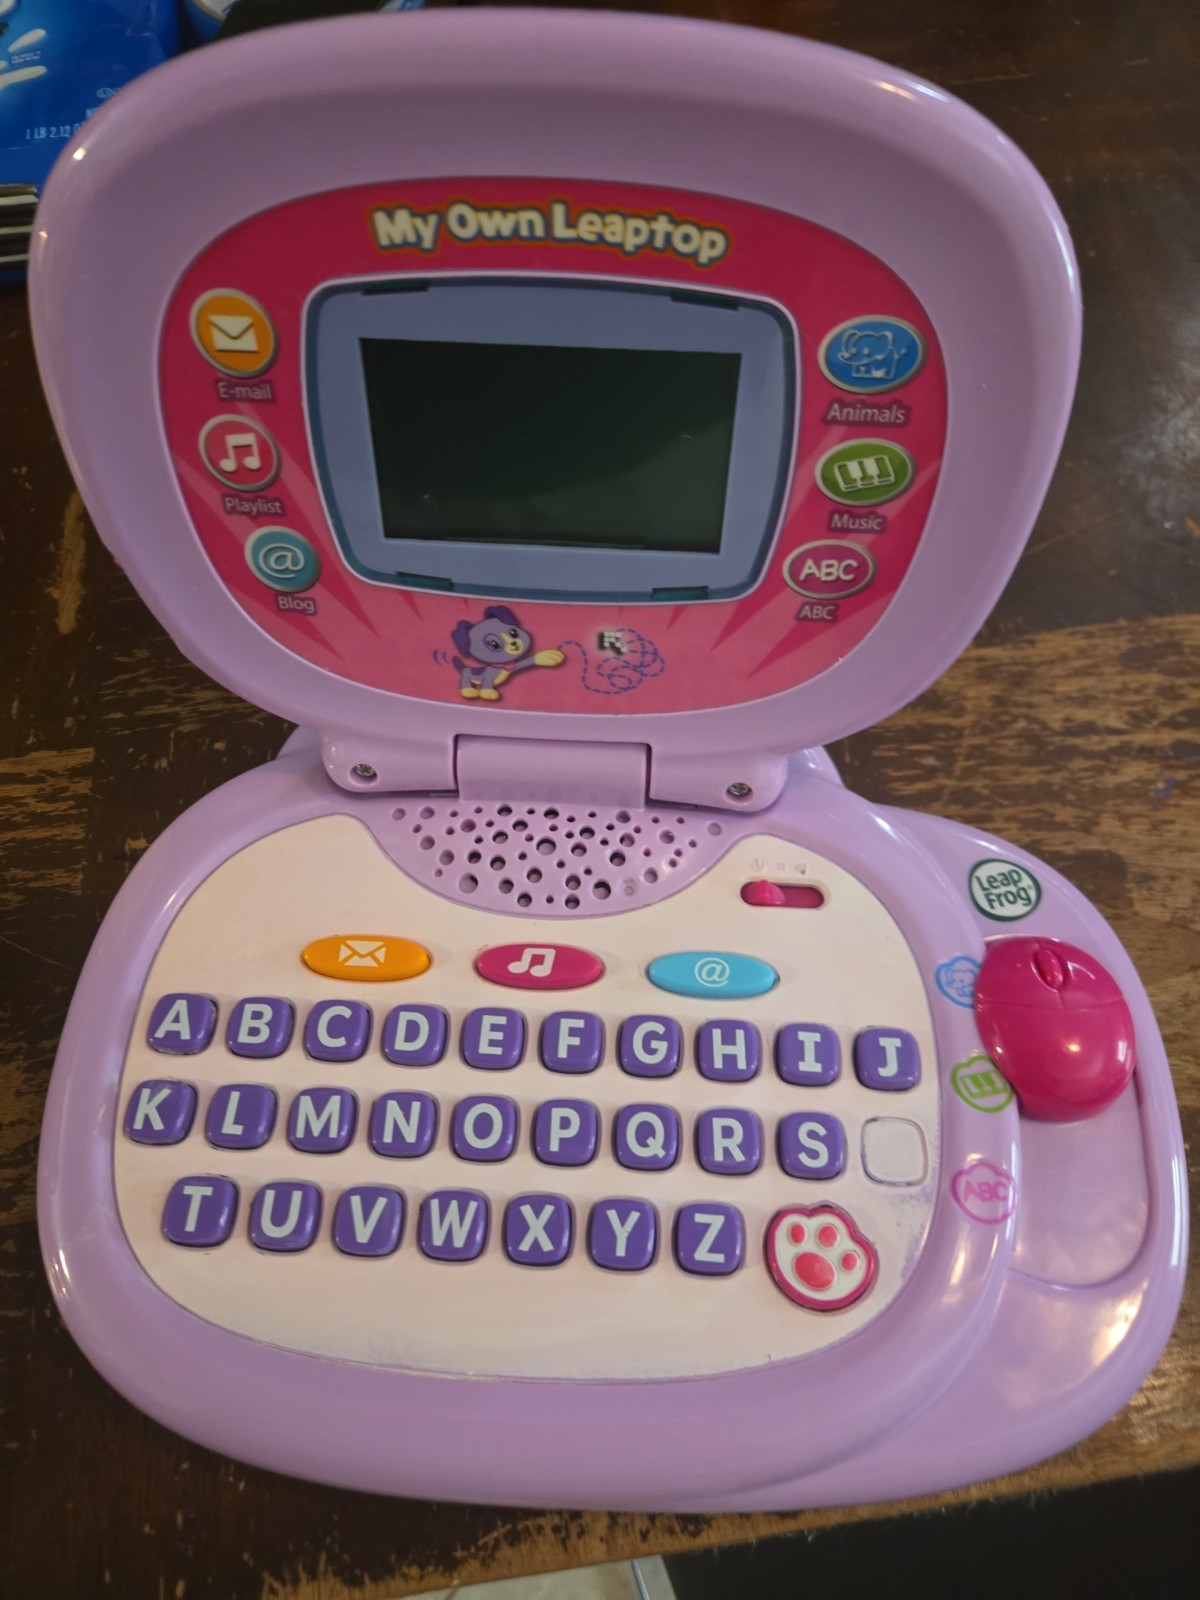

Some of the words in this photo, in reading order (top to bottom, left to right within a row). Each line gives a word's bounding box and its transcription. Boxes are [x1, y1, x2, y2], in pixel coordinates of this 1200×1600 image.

[34, 127, 46, 139] LB
[49, 125, 71, 138] 2.12
[373, 208, 437, 249] My
[447, 203, 544, 240] Own
[550, 204, 727, 264] Leaptop
[218, 382, 272, 400] E-mail
[826, 404, 906, 423] Animals
[224, 497, 282, 514] Playlist
[830, 513, 882, 531] Music
[800, 560, 858, 582] ABC
[277, 596, 315, 613] Blog
[800, 604, 836, 621] ABC
[976, 870, 1022, 893] Leap
[154, 999, 191, 1040] A
[237, 1003, 273, 1044] B
[317, 1005, 352, 1048] C
[394, 1011, 429, 1051] D
[478, 1015, 507, 1055] E
[557, 1018, 585, 1059] F
[632, 1021, 668, 1064] G
[712, 1028, 747, 1070] H
[797, 1031, 823, 1073] I
[877, 1037, 902, 1078] J
[133, 1085, 172, 1131] K
[221, 1091, 244, 1135] L
[295, 1095, 343, 1138] M
[383, 1099, 421, 1143] N
[463, 1103, 503, 1149] O
[549, 1107, 580, 1152] P
[626, 1111, 666, 1158] Q
[712, 1117, 746, 1162] R
[798, 1121, 829, 1168] S
[962, 1177, 1009, 1202] ABC
[182, 1184, 214, 1232] T
[260, 1190, 303, 1237] U
[350, 1194, 389, 1244] V
[429, 1198, 478, 1248] W
[518, 1204, 555, 1252] X
[606, 1209, 640, 1257] Y
[694, 1213, 725, 1263] Z
